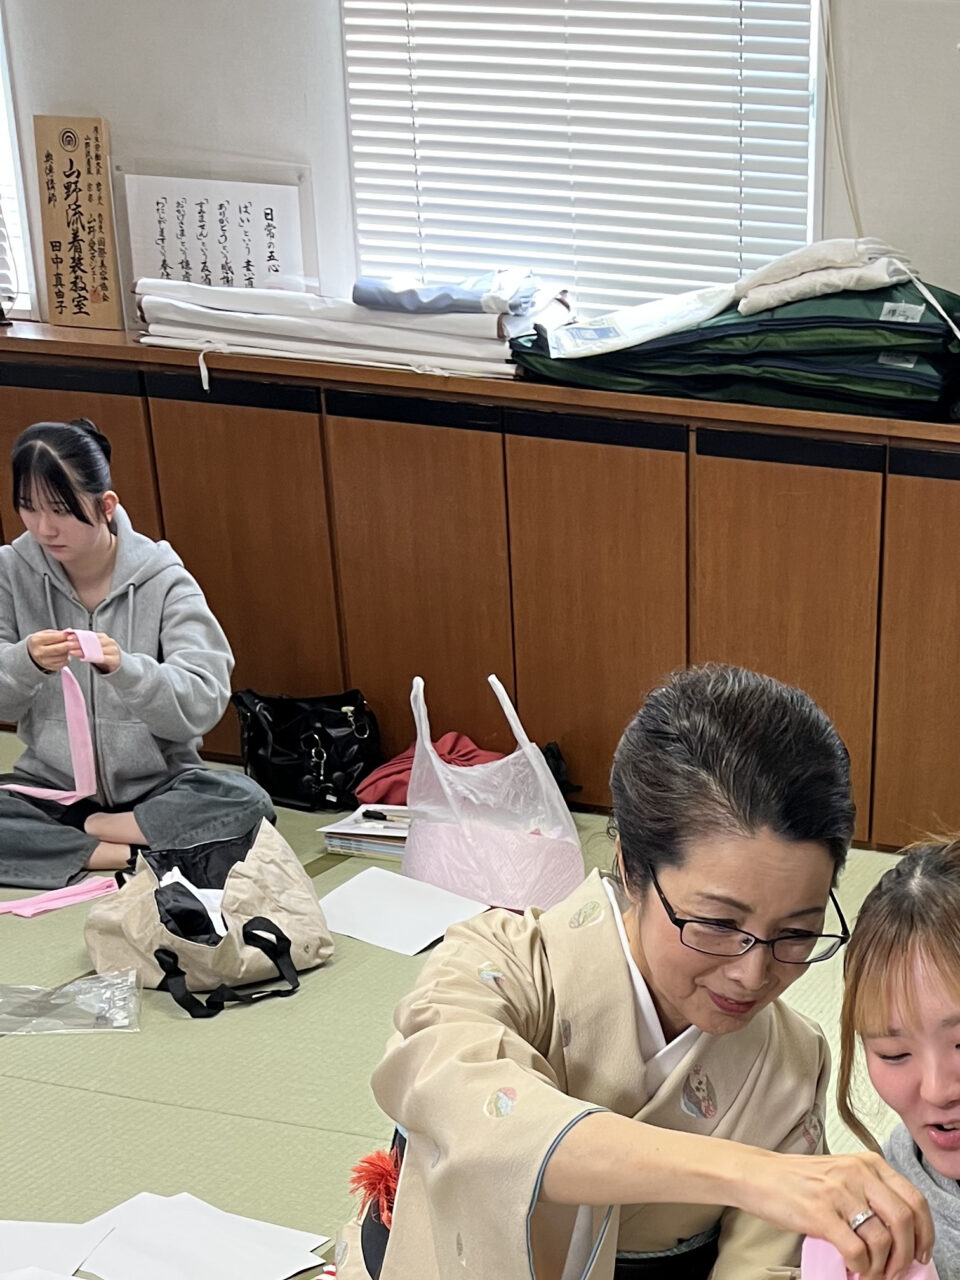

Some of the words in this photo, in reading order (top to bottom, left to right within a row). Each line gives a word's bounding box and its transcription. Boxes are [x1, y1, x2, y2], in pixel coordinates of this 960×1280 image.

[62, 157, 91, 317] 山野流着装教室
[263, 207, 281, 273] 日常の五心
